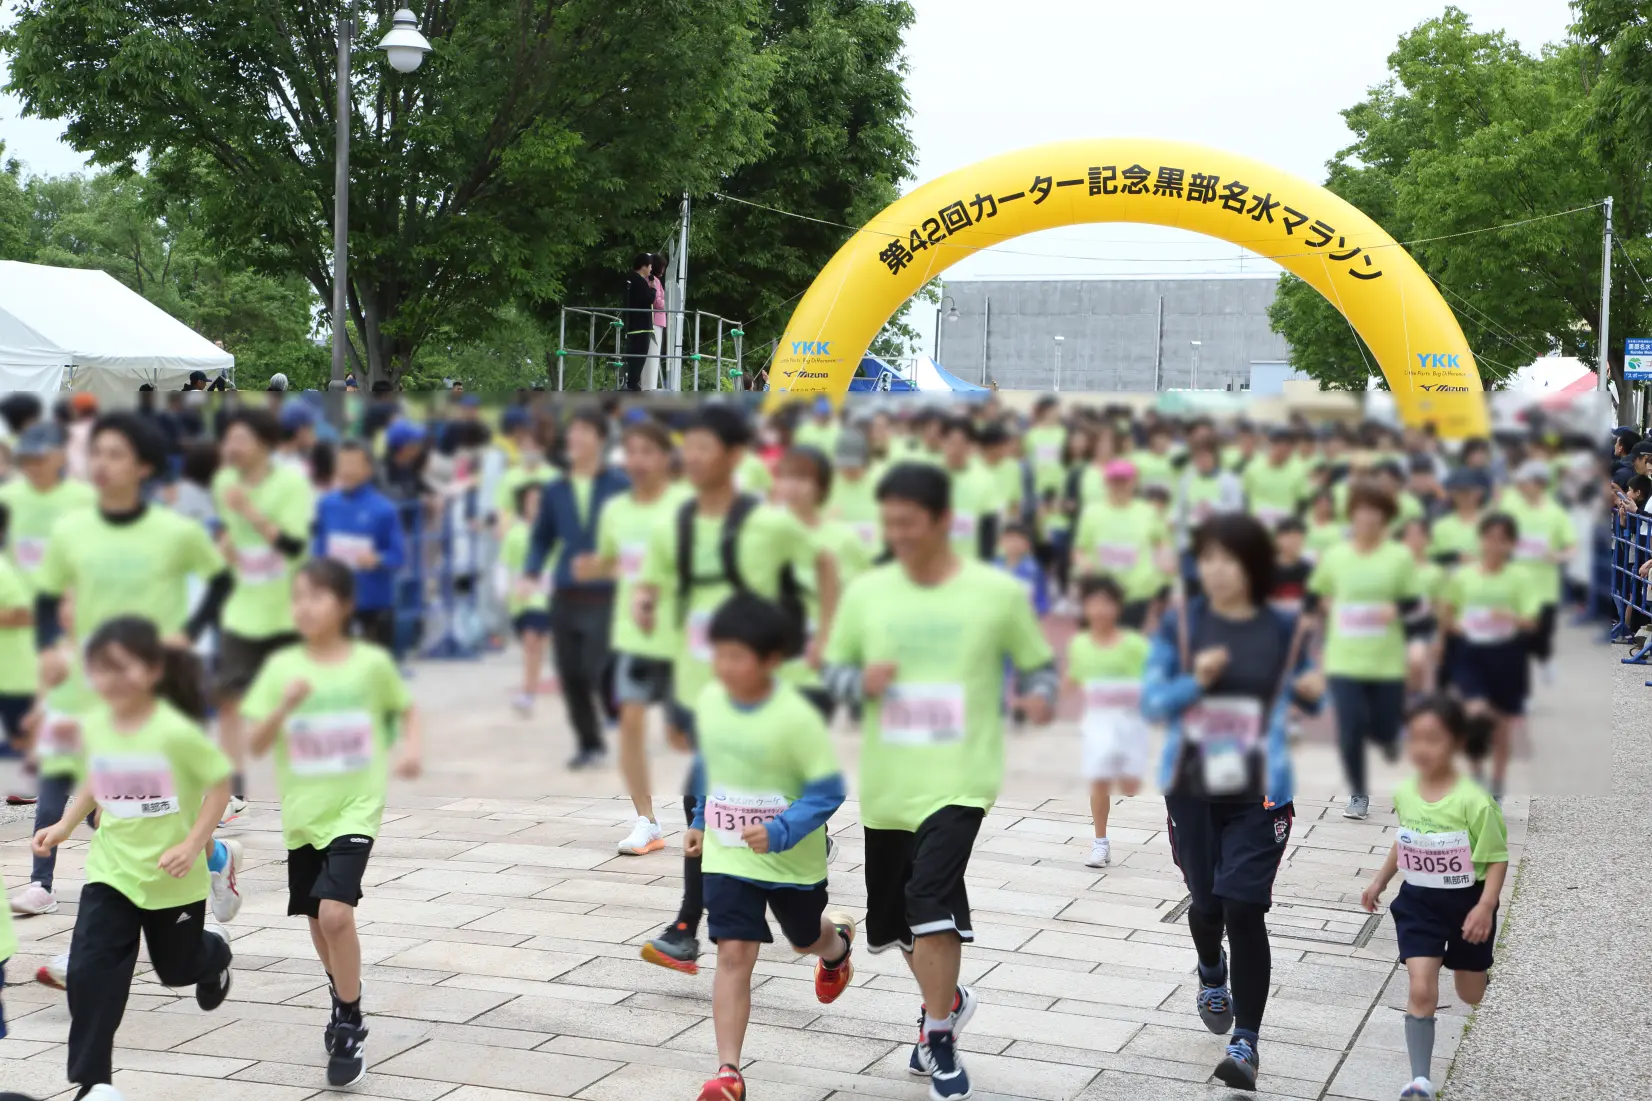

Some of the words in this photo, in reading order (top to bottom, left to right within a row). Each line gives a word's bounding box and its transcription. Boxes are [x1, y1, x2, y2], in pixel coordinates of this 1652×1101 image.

[879, 164, 1383, 280] 第42回カーター記念黒部名水マラソン
[791, 341, 831, 355] YKK
[1416, 353, 1460, 368] YKK
[142, 801, 170, 813] 黒部市
[715, 811, 775, 831] 131
[1403, 853, 1463, 873] 13056
[1443, 875, 1469, 884] 黒部市
